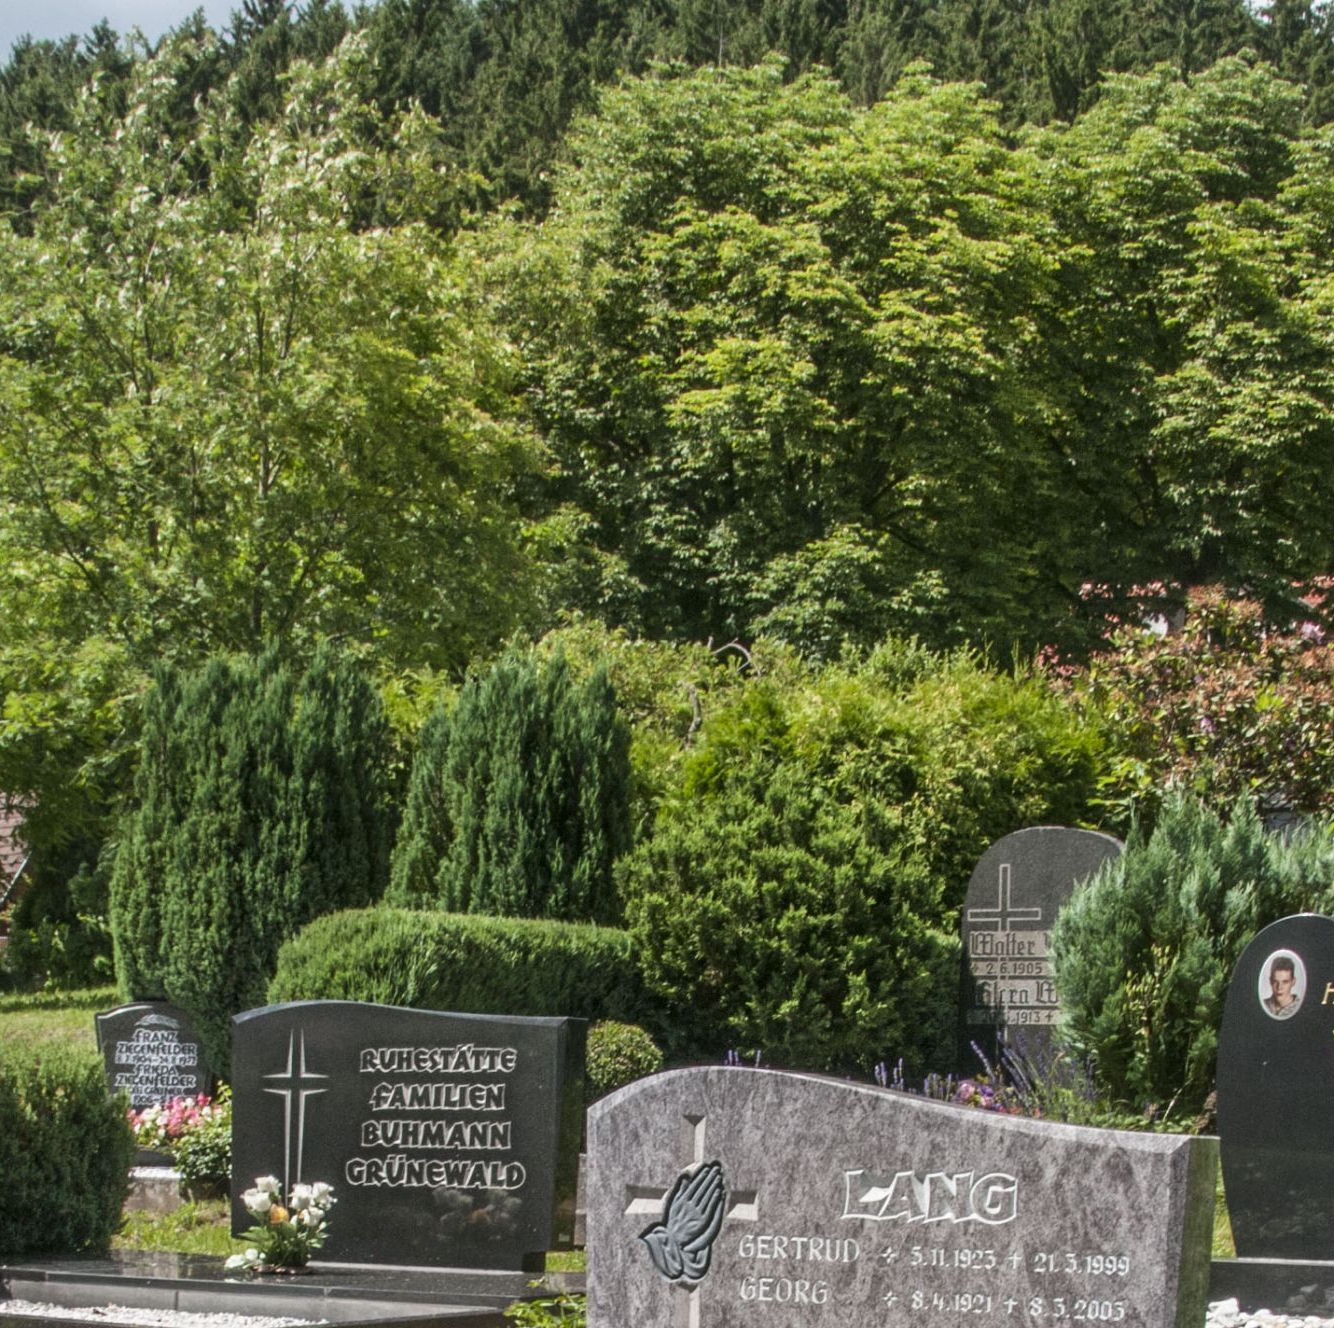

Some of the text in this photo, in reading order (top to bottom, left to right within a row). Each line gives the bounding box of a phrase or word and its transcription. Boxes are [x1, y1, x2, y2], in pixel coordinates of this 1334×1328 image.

[970, 931, 1036, 956] Walter
[133, 1028, 178, 1042] FRANZ
[360, 1043, 517, 1073] RUHESTÄTTE
[370, 1082, 506, 1111] FAMILIEN
[361, 1120, 511, 1149] BUHMANN
[346, 1154, 526, 1190] GRÜNEWALD
[840, 1169, 1019, 1225] LANG
[738, 1235, 861, 1263] GERTRUD
[740, 1276, 829, 1305] GEORG
